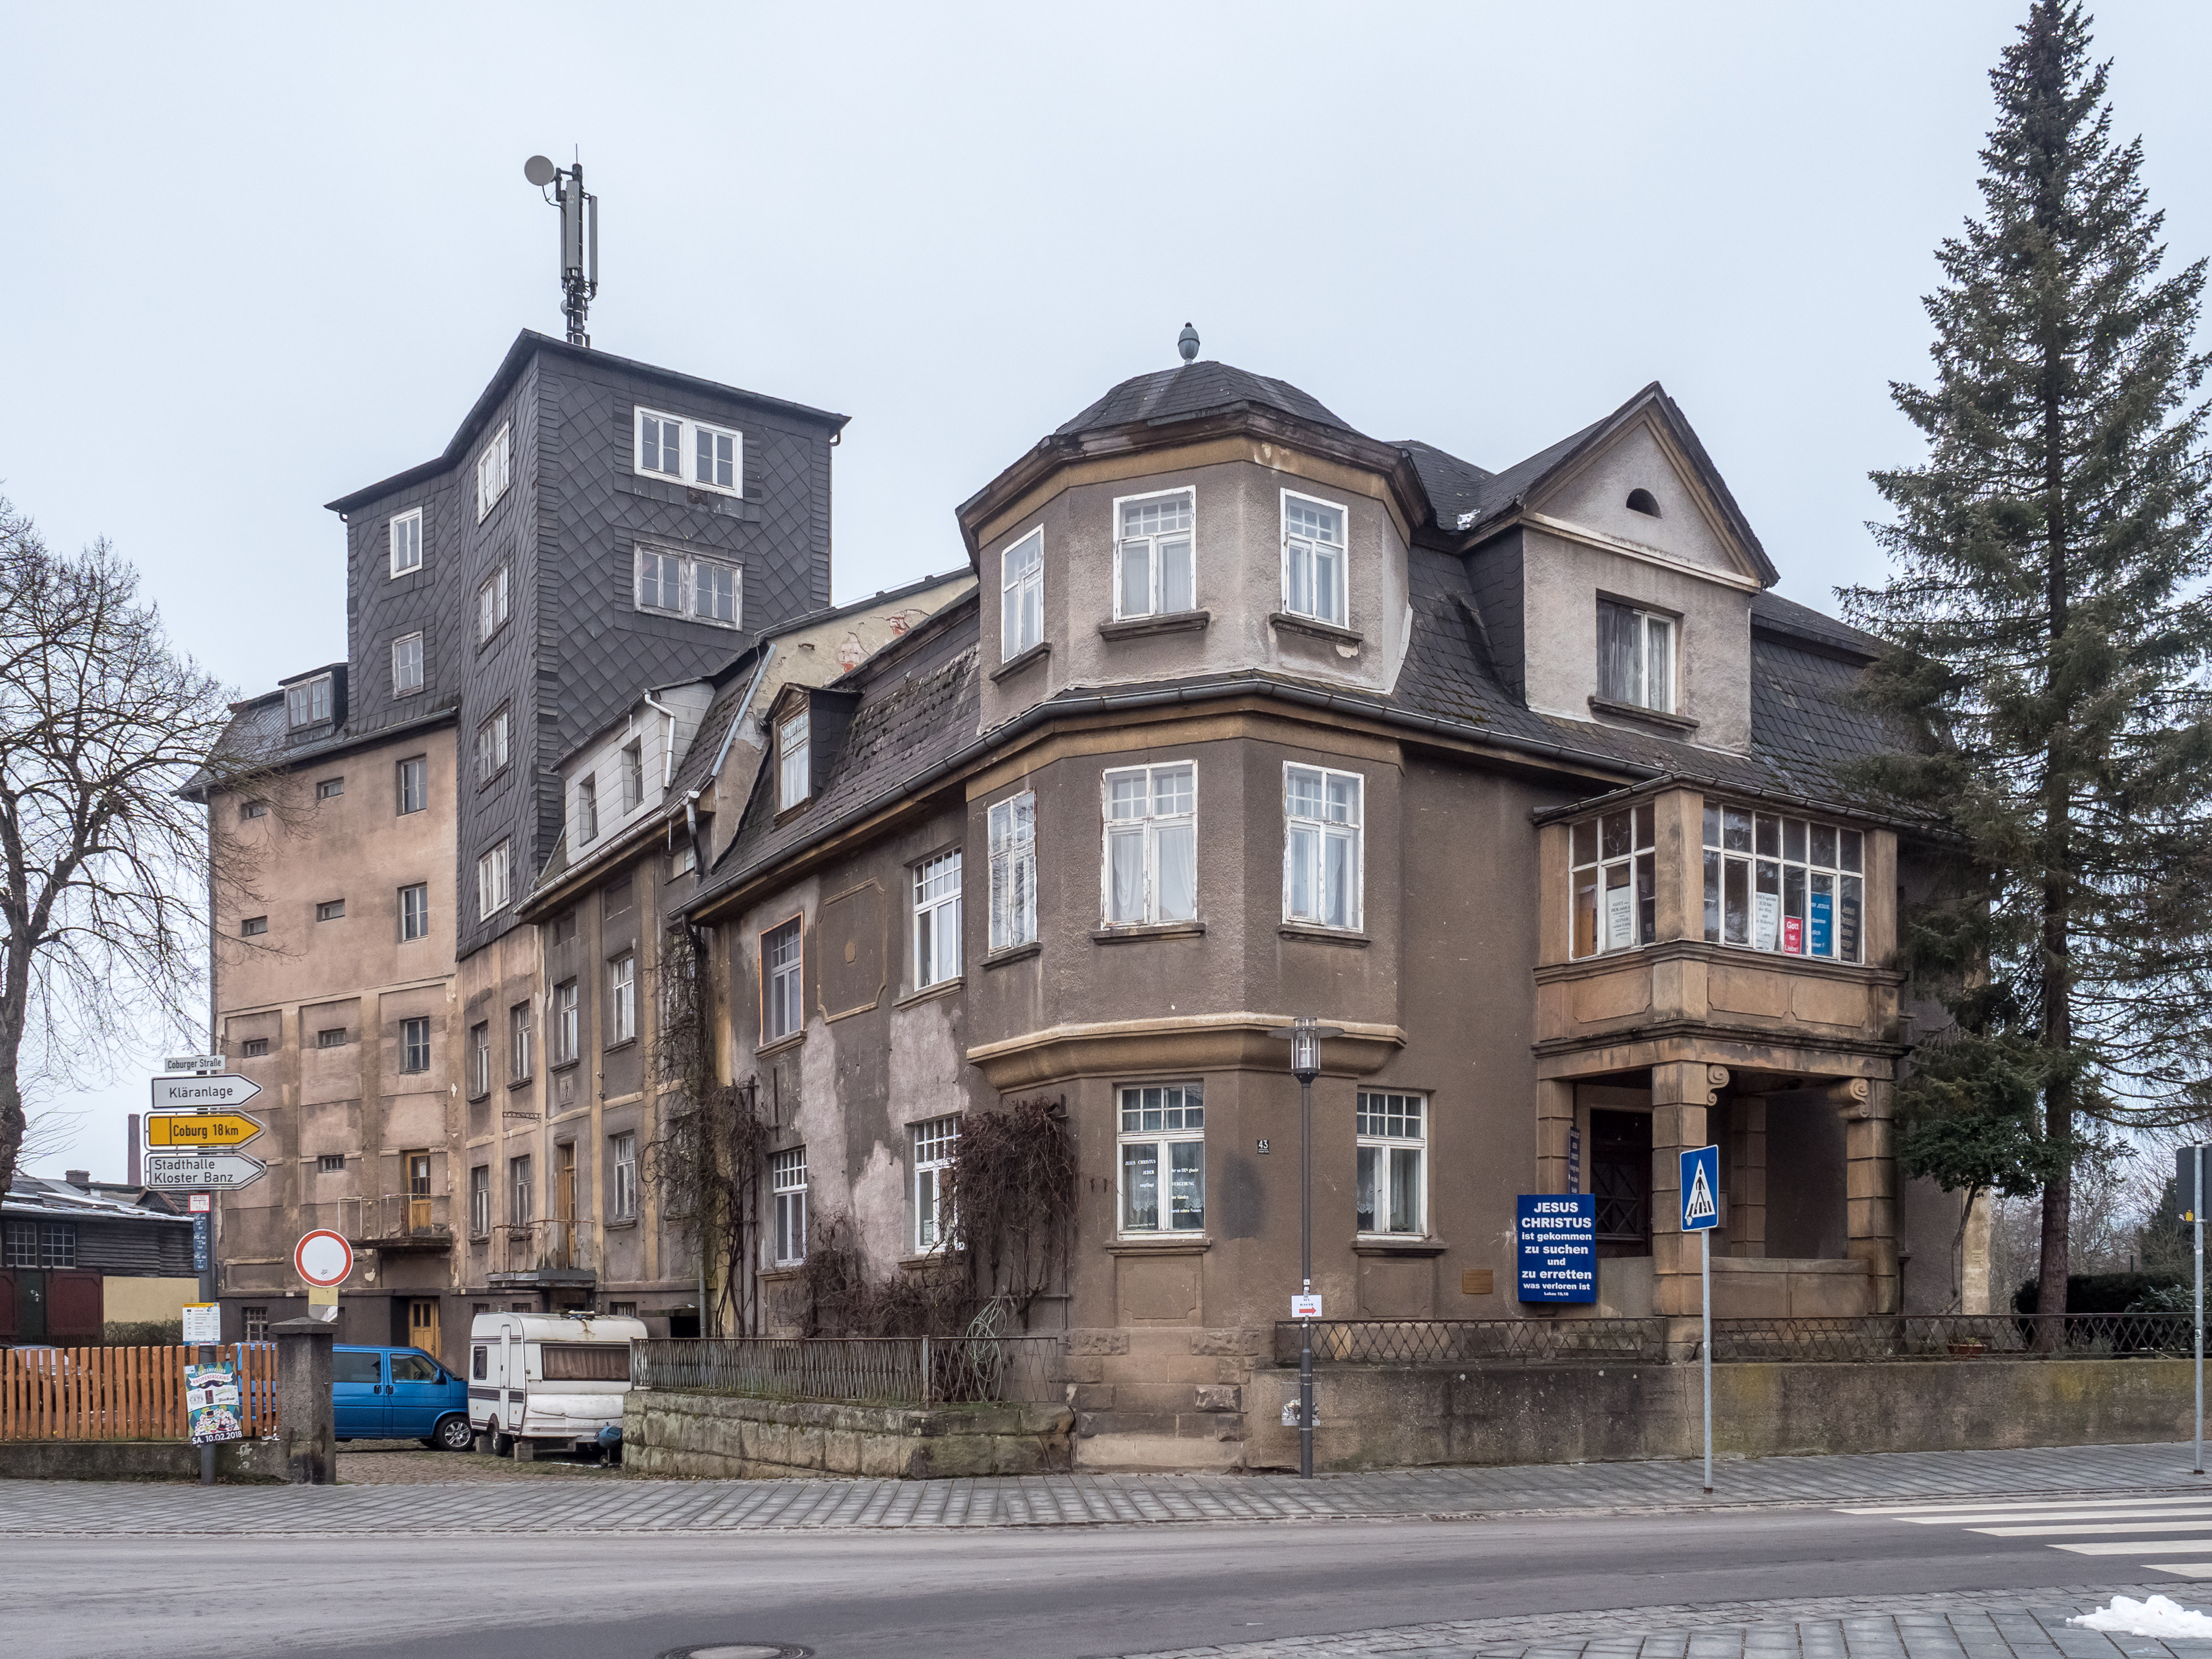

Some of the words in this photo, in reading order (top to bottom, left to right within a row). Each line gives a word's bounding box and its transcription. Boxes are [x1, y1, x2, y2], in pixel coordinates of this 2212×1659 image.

[1787, 922, 1799, 930] Gott
[168, 1059, 197, 1070] Coburger
[200, 1058, 221, 1068] Straße
[169, 1086, 233, 1099] Kläranlage
[173, 1124, 207, 1139] Coburg
[213, 1124, 223, 1136] 18
[225, 1125, 238, 1136] km
[1258, 1140, 1268, 1148] 43
[155, 1158, 215, 1170] Stadthalle
[155, 1173, 198, 1183] Kloster
[204, 1172, 233, 1182] Banz
[1534, 1202, 1579, 1212] JESUS
[1522, 1217, 1592, 1228] CHRISTUS
[1537, 1232, 1592, 1242] gekommen
[1543, 1244, 1588, 1254] suchen
[1540, 1269, 1592, 1279] erretten
[206, 1431, 242, 1442] 10.02.2018
